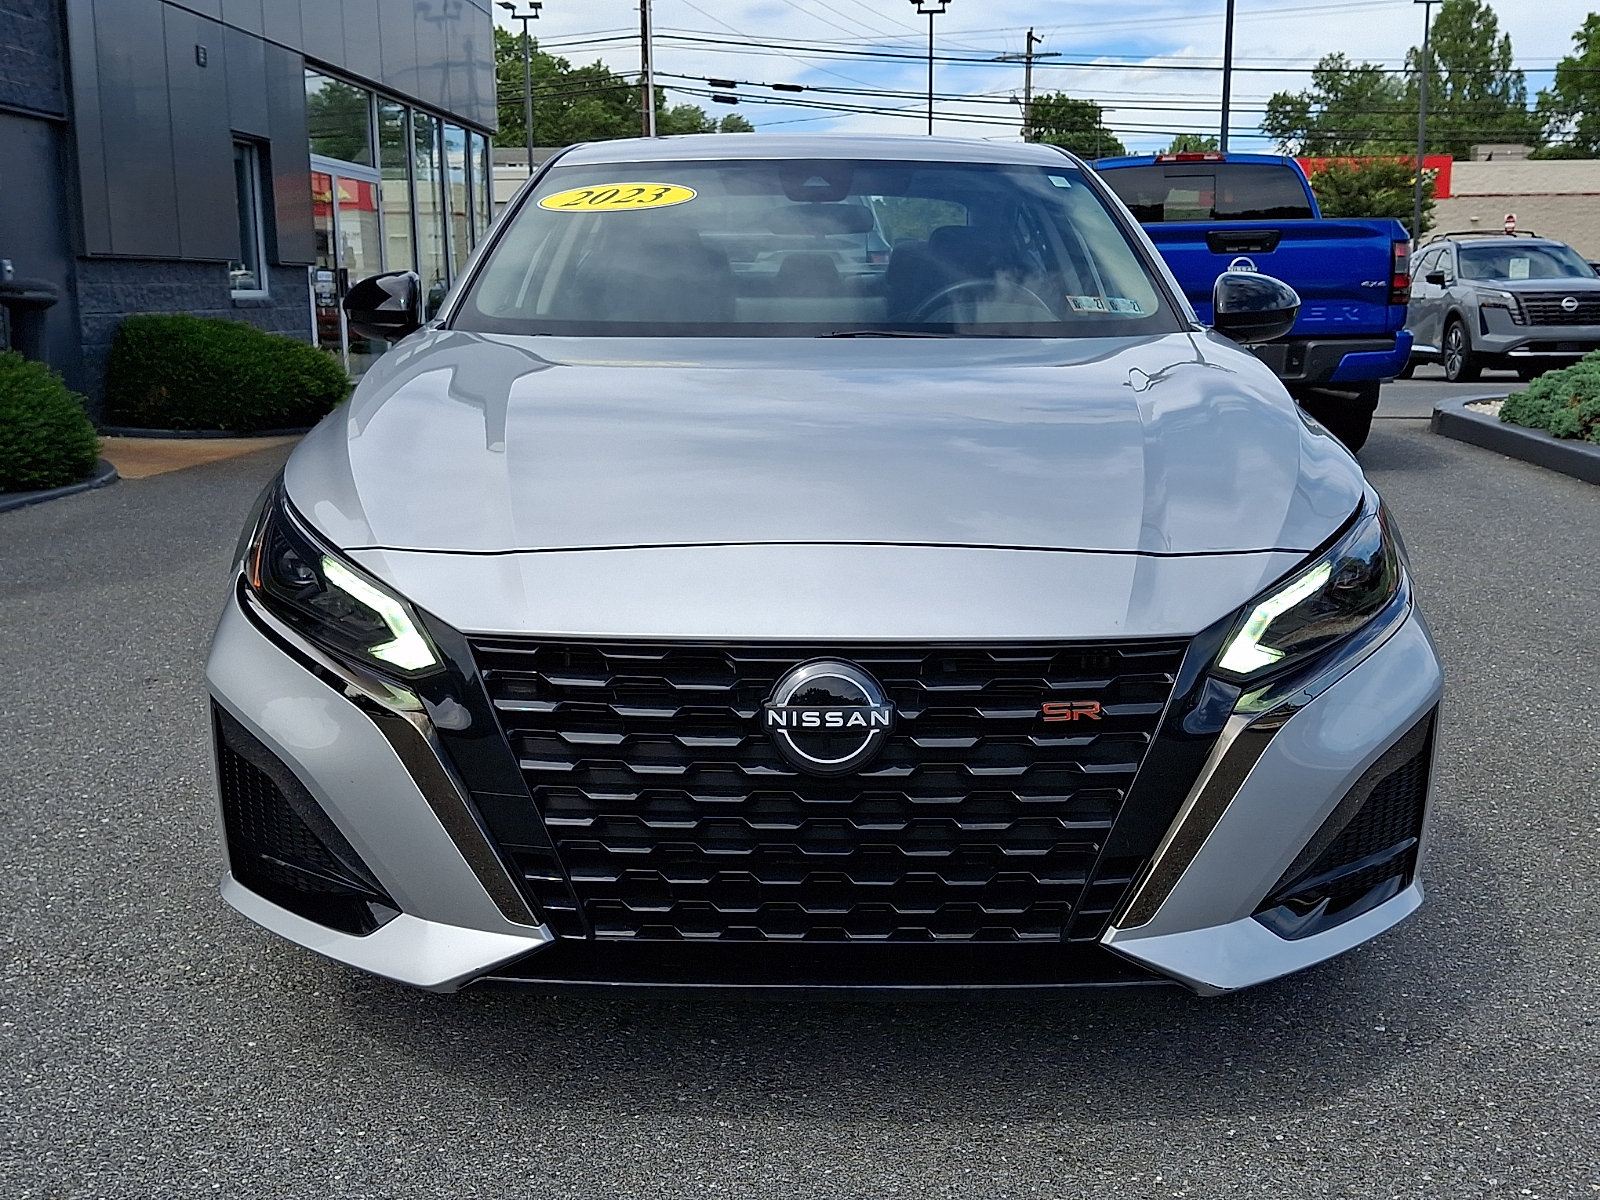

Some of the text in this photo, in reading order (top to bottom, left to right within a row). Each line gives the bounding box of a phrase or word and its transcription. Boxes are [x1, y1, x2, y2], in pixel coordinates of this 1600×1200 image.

[560, 187, 671, 207] 2023
[767, 709, 890, 727] NISSAN
[1042, 701, 1102, 721] SR
